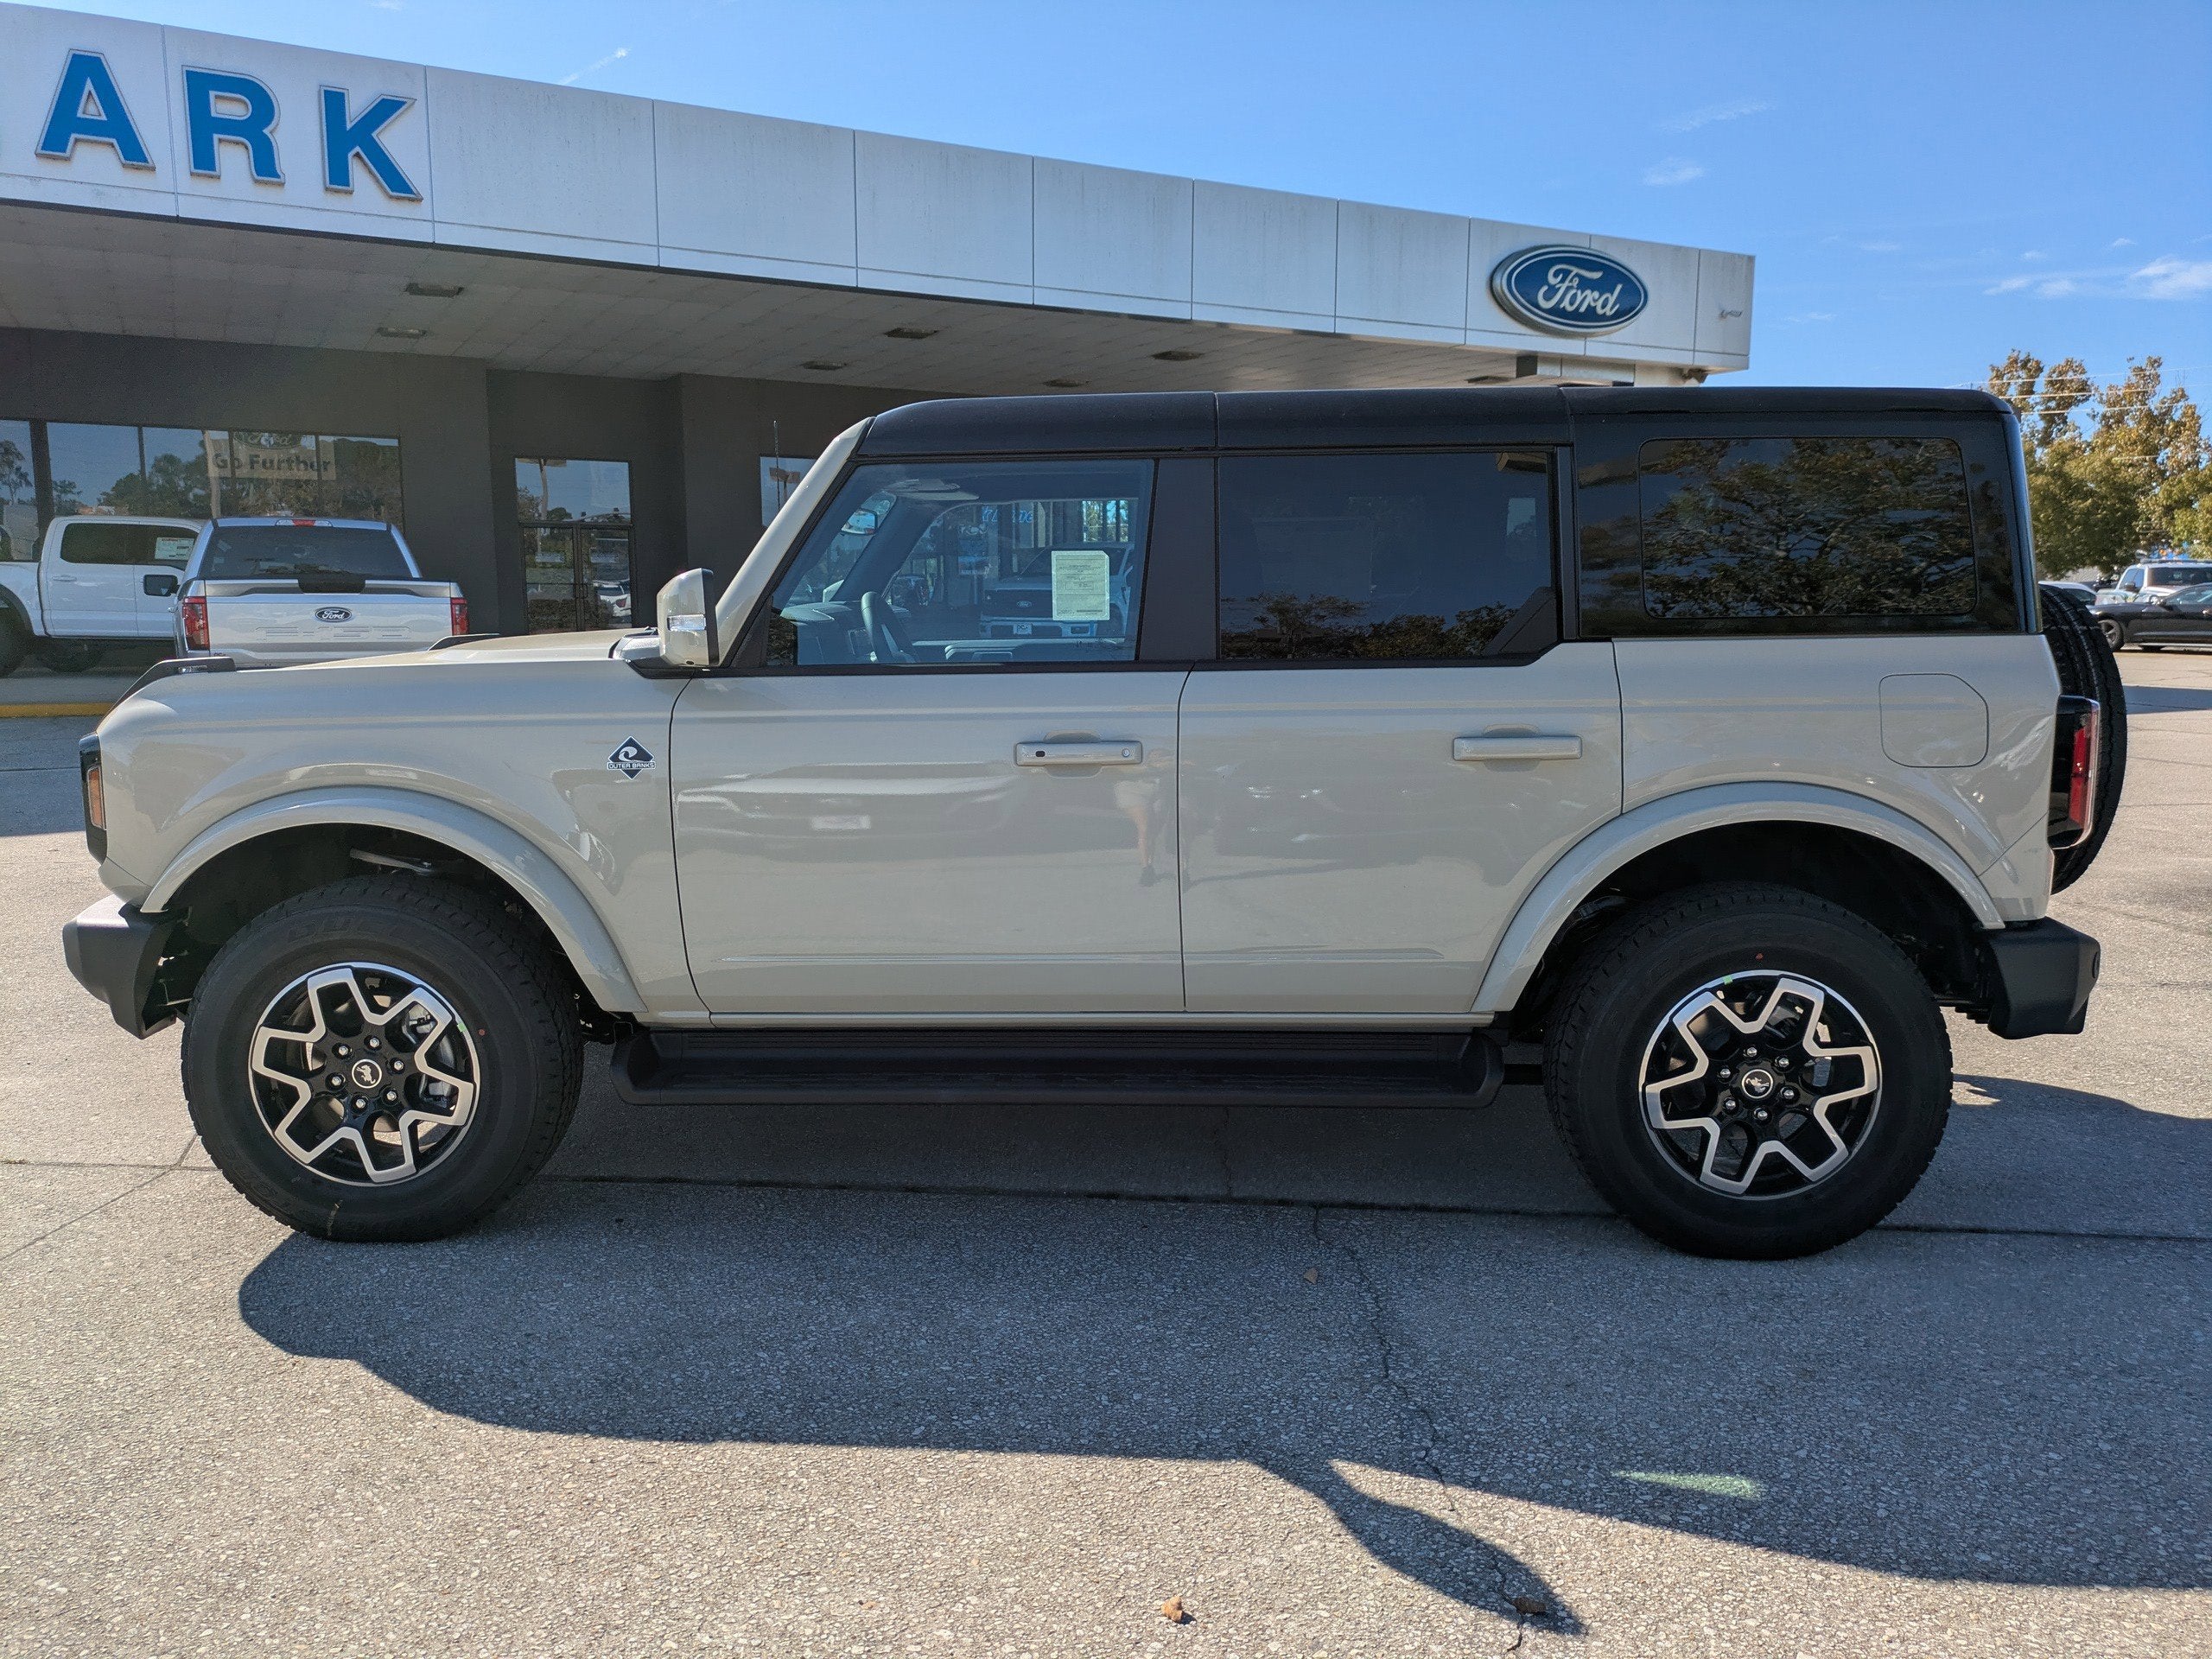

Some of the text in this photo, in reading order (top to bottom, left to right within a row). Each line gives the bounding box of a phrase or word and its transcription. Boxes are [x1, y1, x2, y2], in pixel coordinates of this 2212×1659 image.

[35, 48, 423, 201] ARK
[1537, 264, 1623, 315] Ford
[249, 454, 330, 472] Further
[321, 609, 346, 620] Ford
